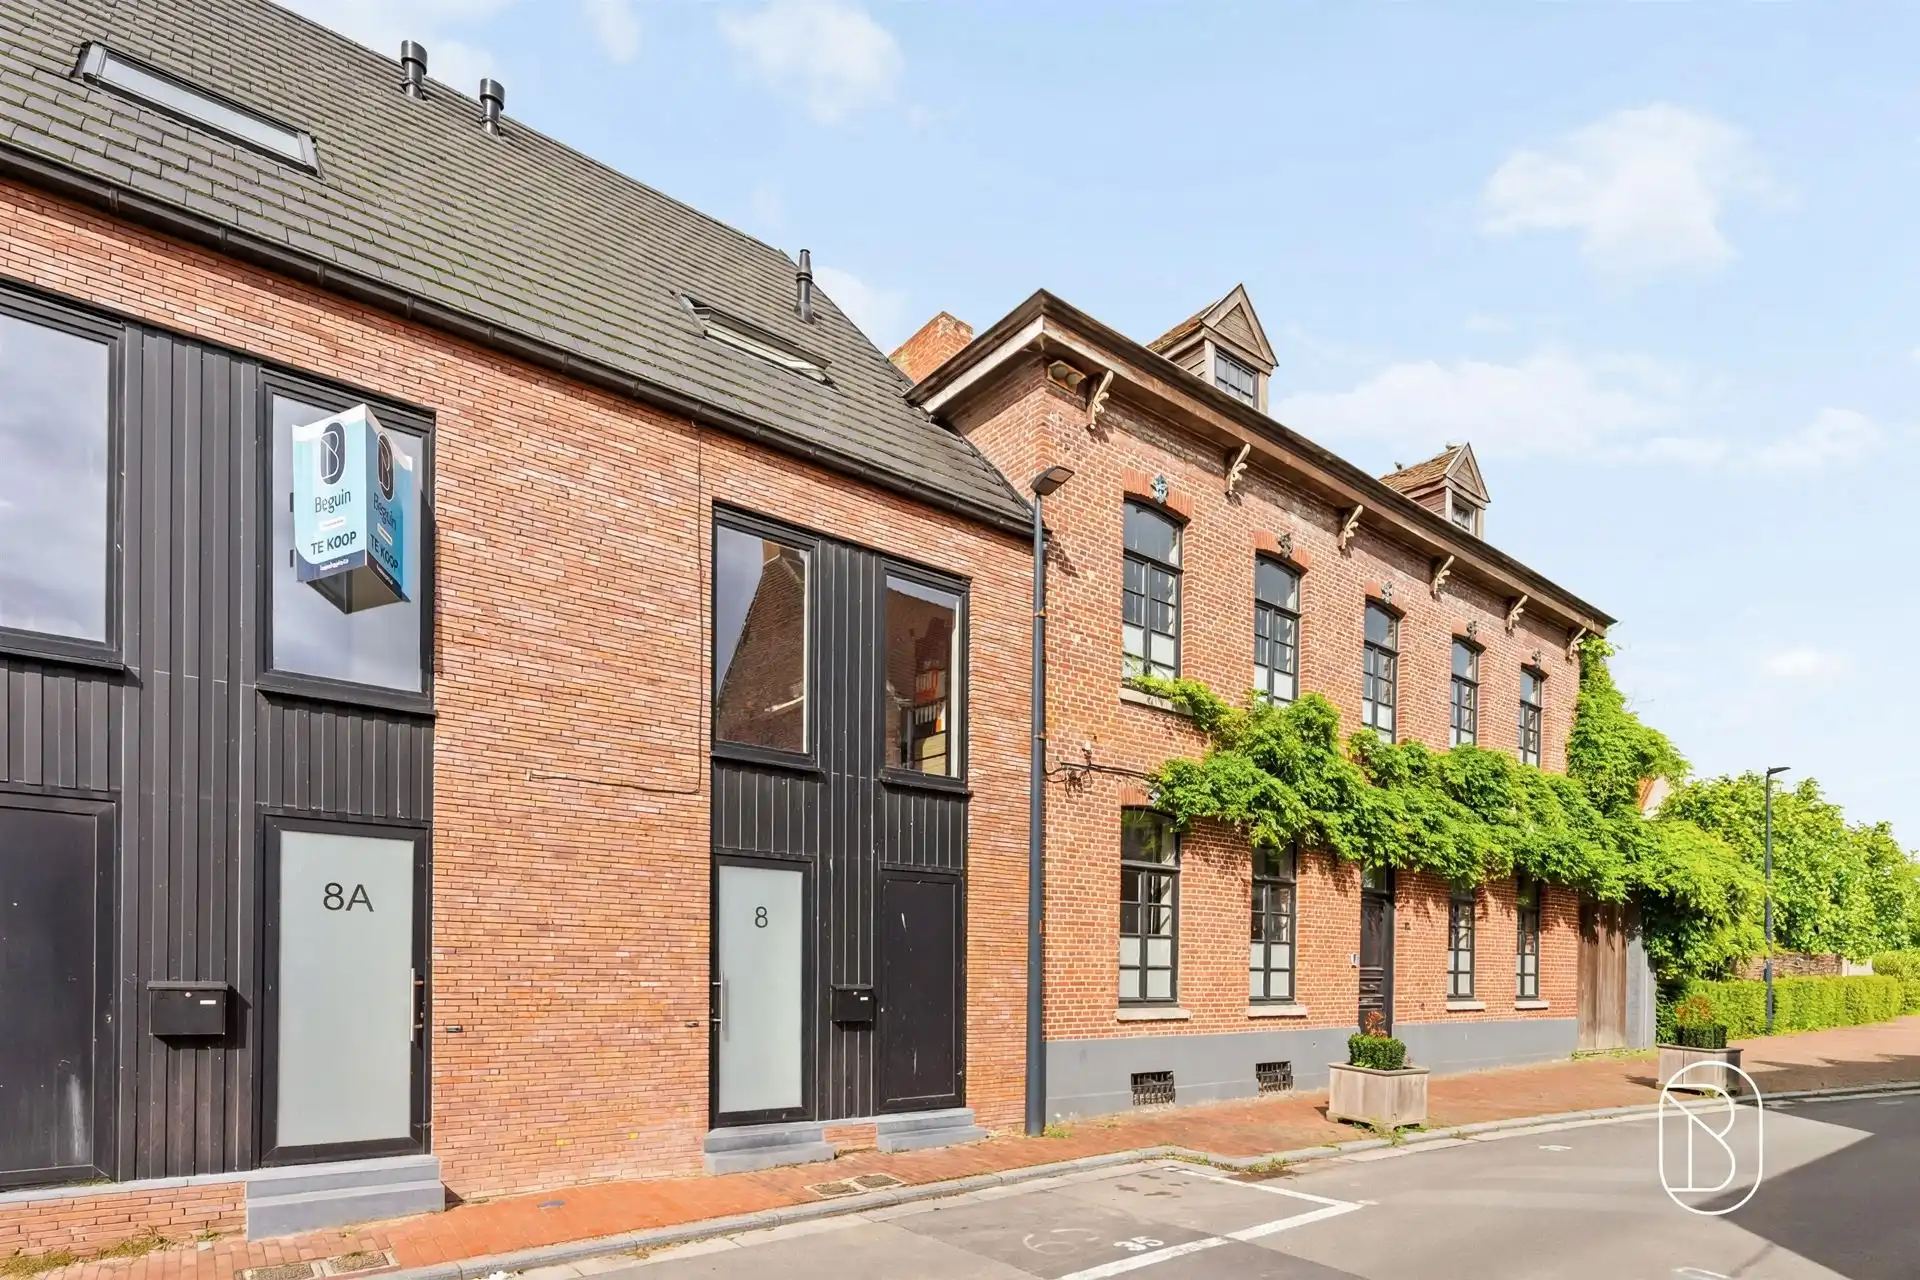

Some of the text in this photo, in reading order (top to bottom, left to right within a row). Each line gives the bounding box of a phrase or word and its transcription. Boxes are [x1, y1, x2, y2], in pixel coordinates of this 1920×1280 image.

[314, 489, 352, 514] Beguin
[310, 531, 357, 555] TE KOOP
[370, 533, 380, 553] TE
[380, 546, 399, 572] KOOP
[322, 882, 374, 912] 8A
[754, 906, 769, 929] 8
